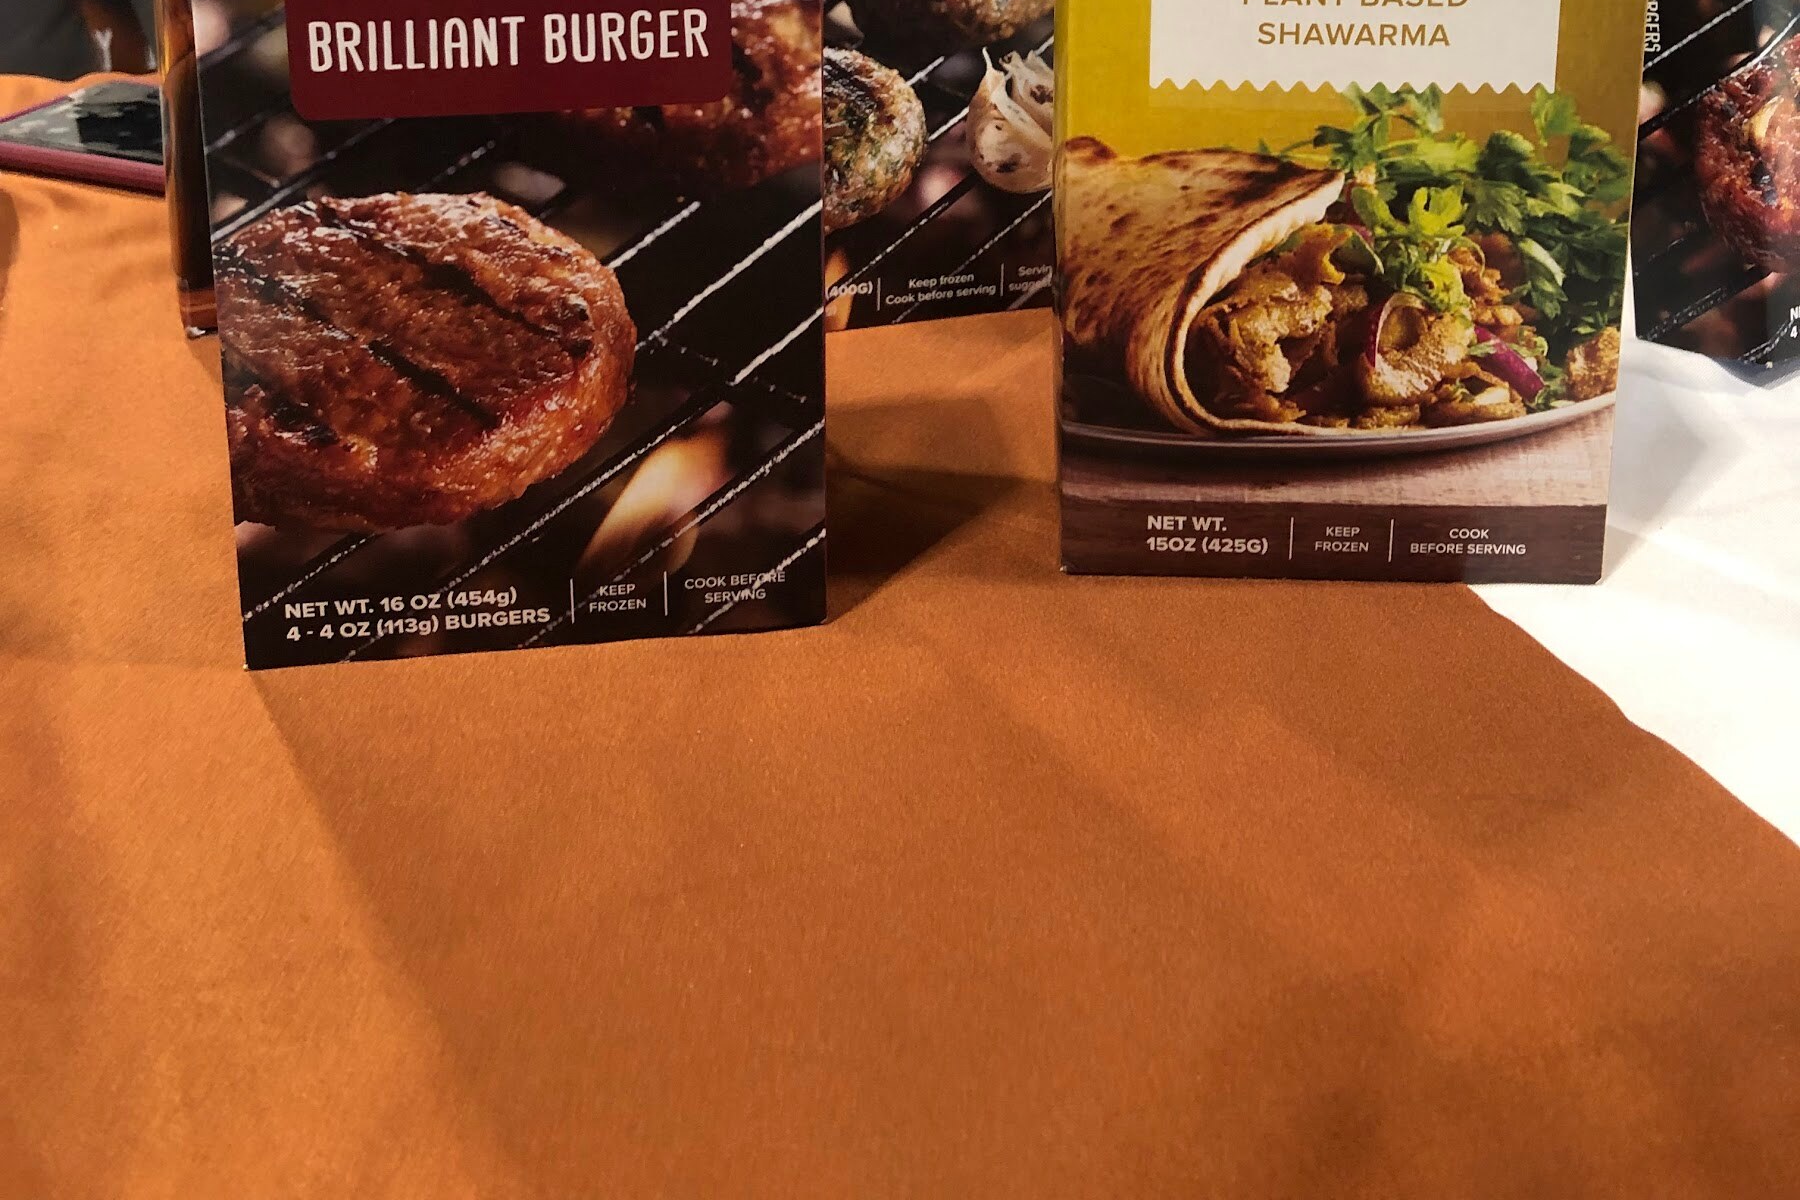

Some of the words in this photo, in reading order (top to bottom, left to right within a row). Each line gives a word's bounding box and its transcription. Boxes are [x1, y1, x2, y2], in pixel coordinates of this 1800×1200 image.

[308, 15, 526, 73] BRILLIANT
[543, 8, 709, 64] BURGER
[1257, 22, 1451, 47] SHAWARMA
[1018, 264, 1052, 277] Servin
[909, 277, 937, 290] Keep
[939, 273, 975, 285] frozen
[825, 280, 873, 301] (400G)
[886, 294, 915, 305] Cook
[917, 289, 953, 302] before
[956, 284, 996, 297] serving
[1146, 514, 1186, 532] NET
[1191, 515, 1227, 532] WT.
[1325, 526, 1360, 537] KEEP
[1449, 528, 1489, 539] COOK
[1146, 536, 1196, 553] 15OZ
[1202, 536, 1269, 555] (425G)
[1315, 540, 1369, 552] FROZEN
[1410, 542, 1464, 554] BEFORE
[1467, 542, 1526, 555] SERVING
[684, 576, 727, 590] COOK
[730, 571, 786, 586] BEFORE
[599, 583, 635, 596] KEEP
[704, 588, 767, 604] SERVING
[285, 601, 328, 619] NET
[334, 599, 375, 615] WT.
[380, 596, 404, 612] 16
[410, 593, 441, 610] OZ
[448, 586, 517, 609] (454g)
[589, 598, 647, 613] FROZEN
[286, 626, 301, 641] 4
[319, 624, 334, 639] 4
[339, 621, 371, 638] OZ
[377, 615, 439, 638] (113g)
[445, 607, 551, 630] BURGERS
